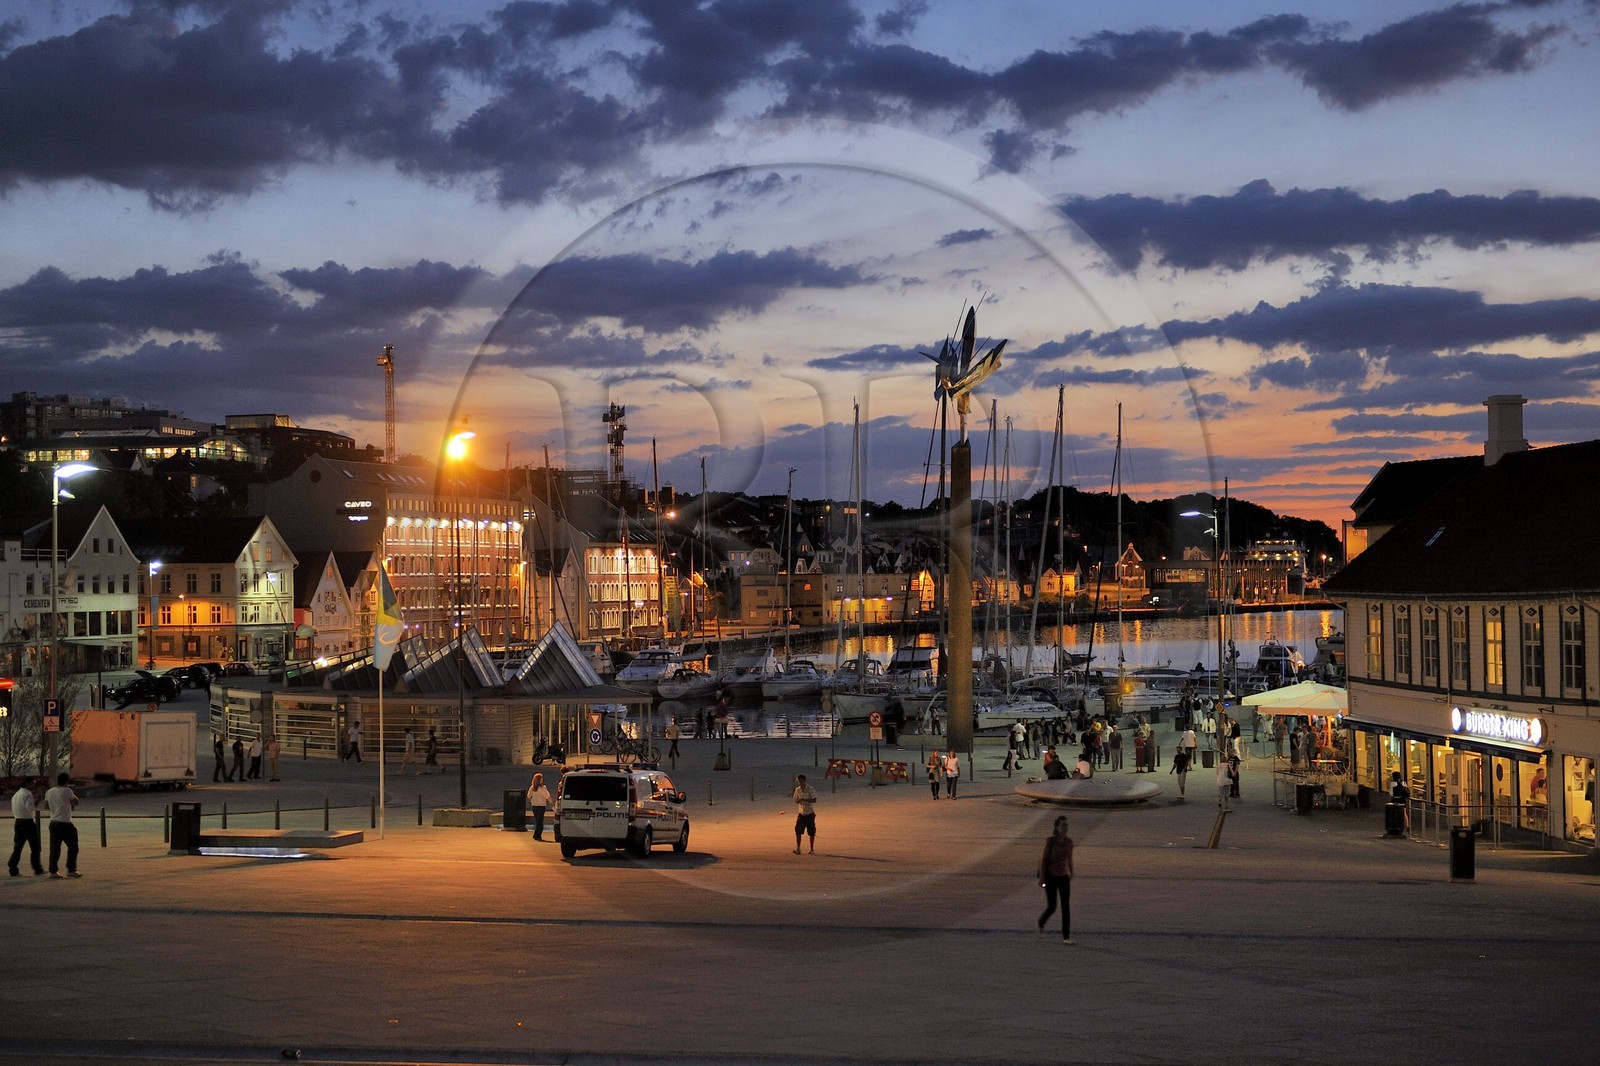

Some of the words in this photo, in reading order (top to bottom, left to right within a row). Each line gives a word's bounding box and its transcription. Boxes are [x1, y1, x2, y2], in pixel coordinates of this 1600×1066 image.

[344, 500, 372, 508] CAVEO
[48, 701, 57, 715] P
[1466, 712, 1502, 737] BURGER
[1503, 716, 1529, 741] KING
[596, 811, 625, 819] POLITI
